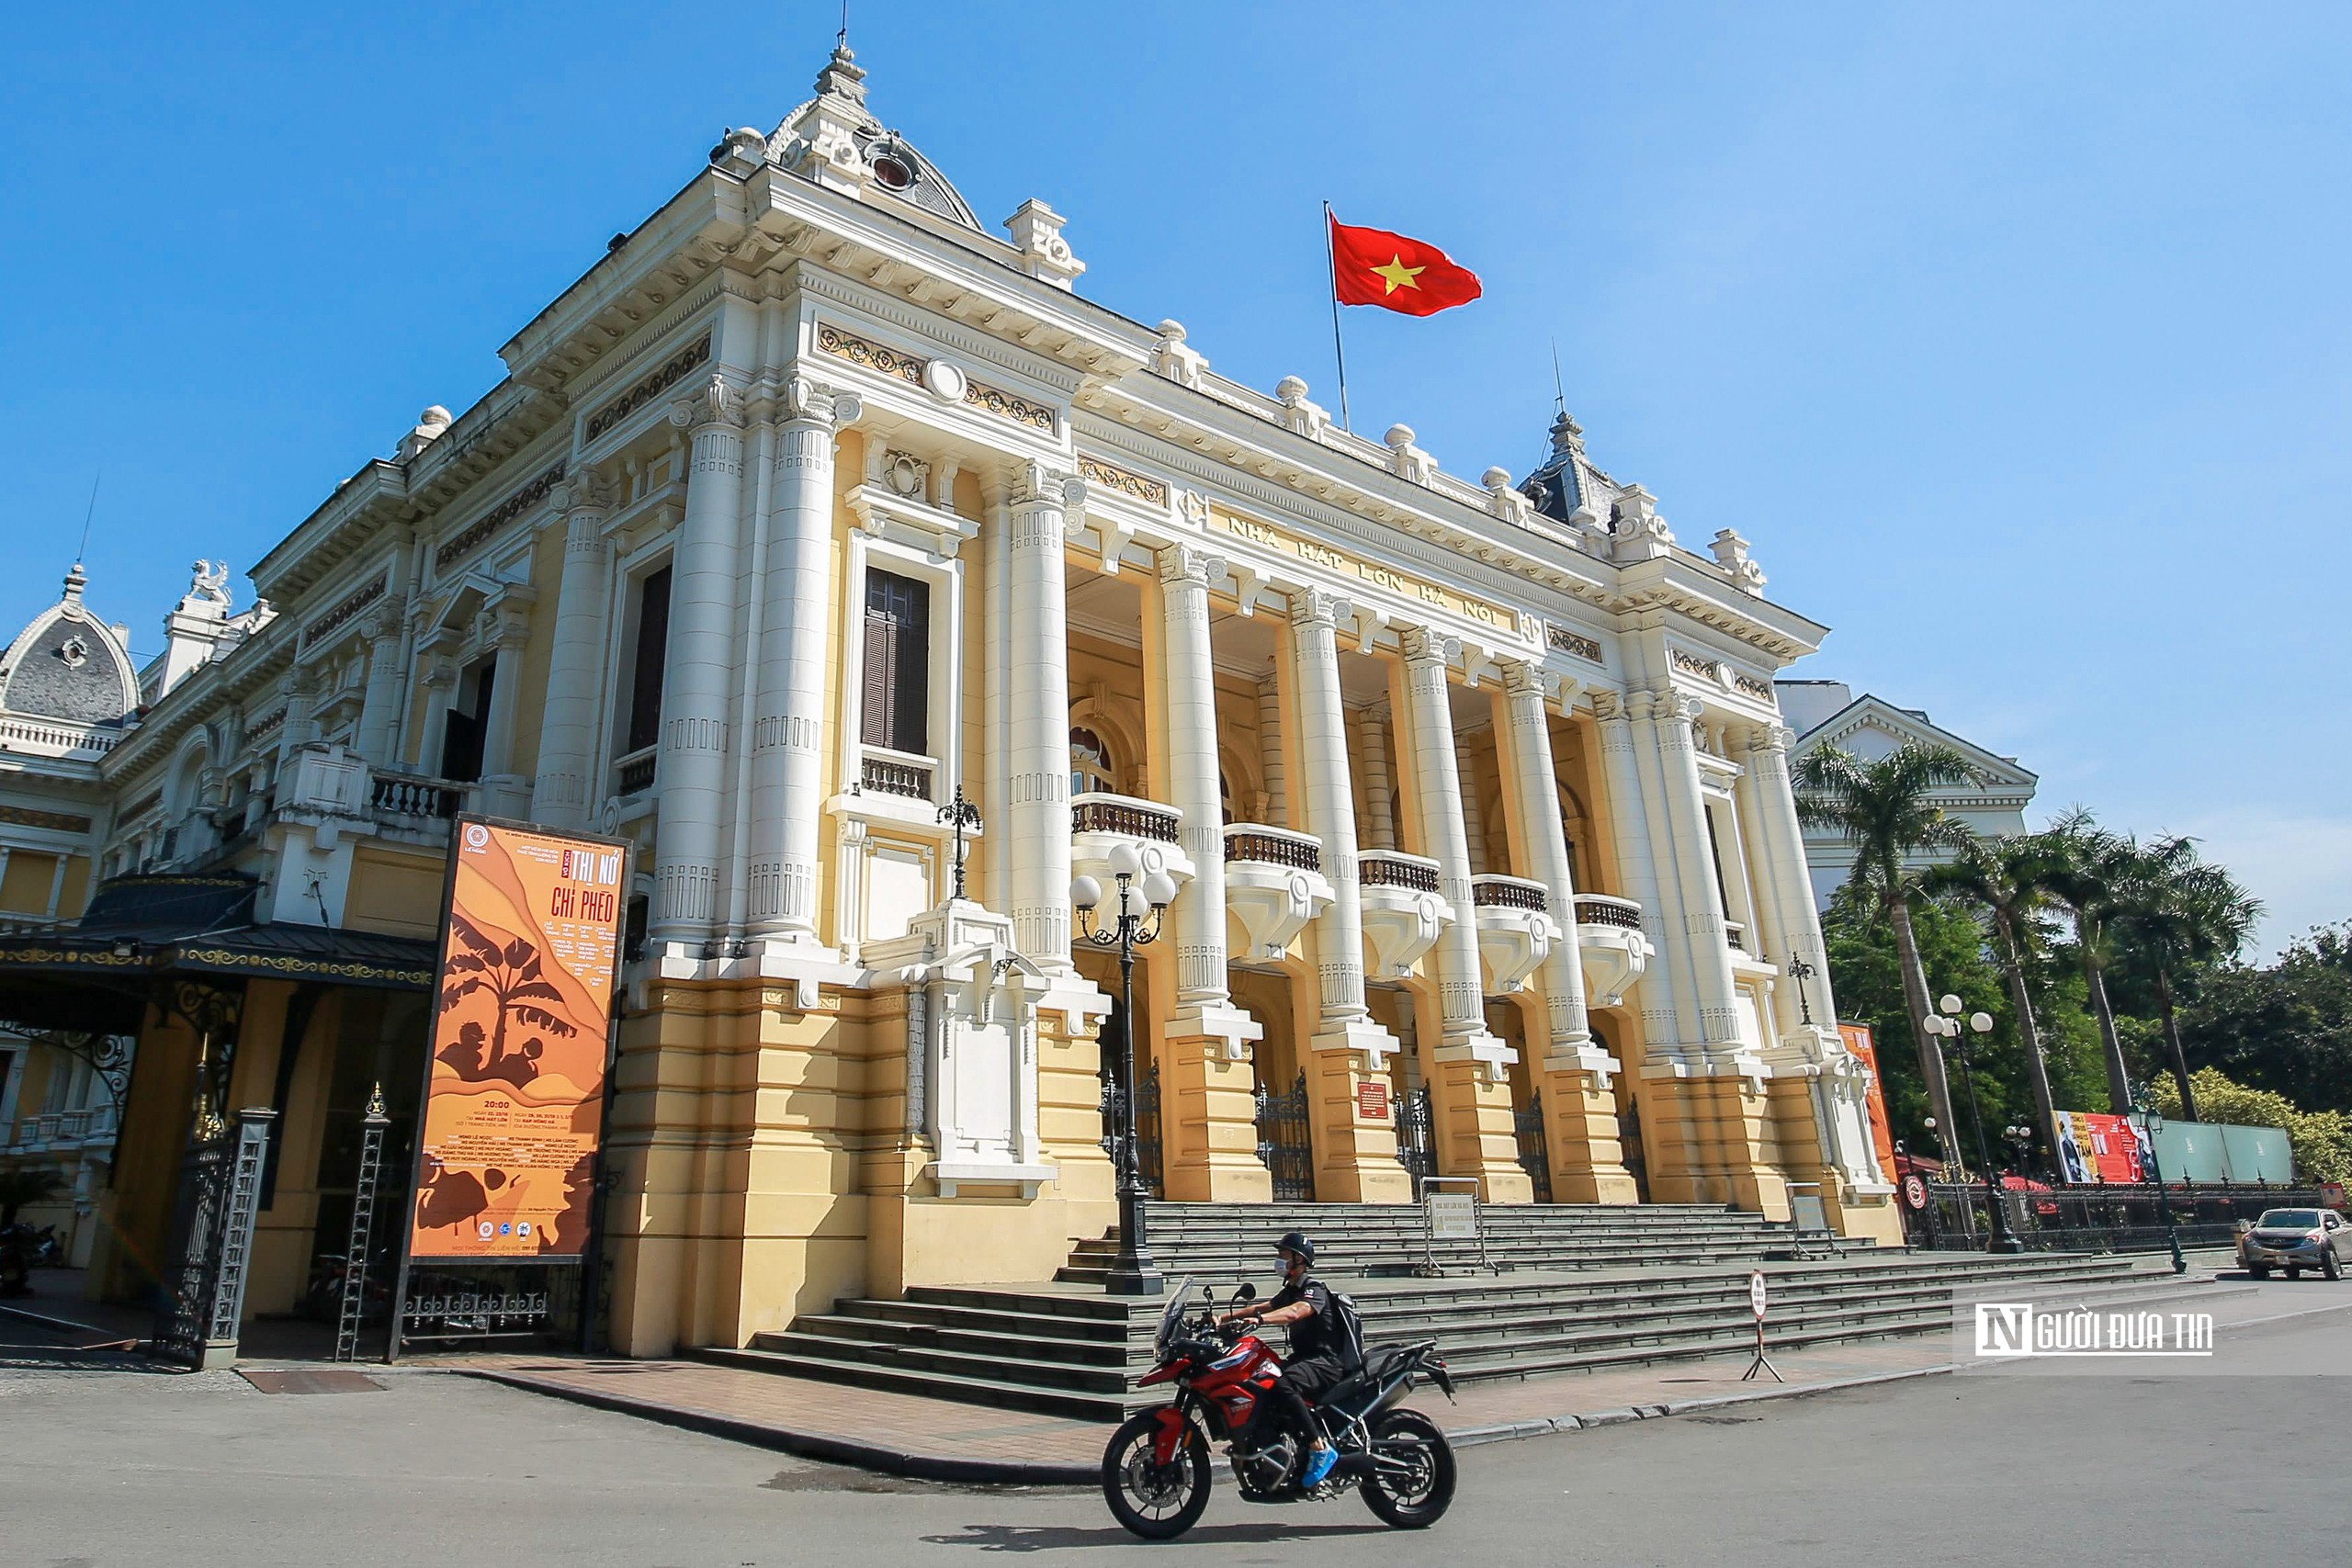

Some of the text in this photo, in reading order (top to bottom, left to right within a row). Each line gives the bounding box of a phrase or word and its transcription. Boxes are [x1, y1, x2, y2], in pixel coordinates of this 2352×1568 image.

[1228, 516, 1281, 549] NHÀ
[1296, 541, 1342, 569] HÁT
[1419, 584, 1447, 607] HÀ
[571, 850, 594, 887] THỊ
[598, 849, 620, 886] NỞ
[551, 886, 614, 923] CHÍ PHÈO
[484, 1100, 509, 1109] 20:00
